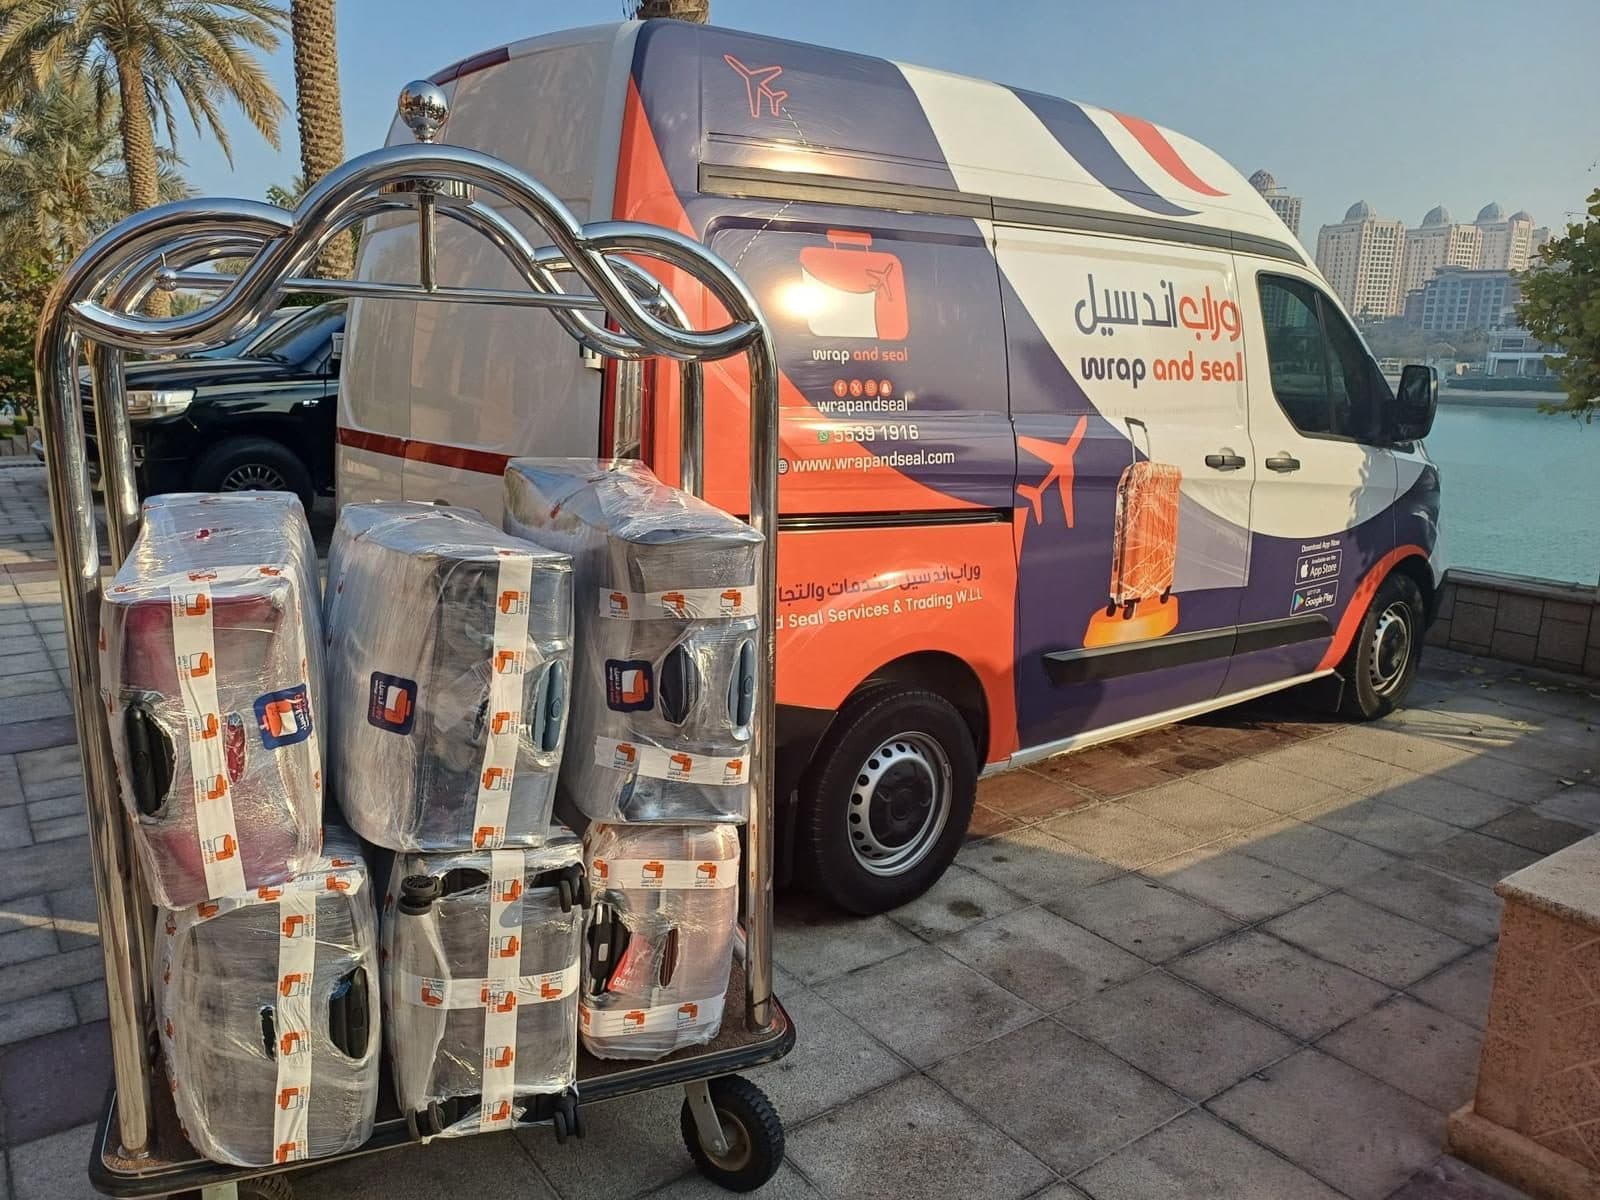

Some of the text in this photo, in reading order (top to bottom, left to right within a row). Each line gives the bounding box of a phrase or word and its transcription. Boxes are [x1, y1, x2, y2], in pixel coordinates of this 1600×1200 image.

[1074, 273, 1242, 342] وراب اندسيل
[812, 347, 908, 364] wrap and seal
[1080, 350, 1244, 389] wrap and seal
[817, 396, 908, 415] wrapandseal
[833, 424, 919, 442] 5539 1916
[792, 450, 955, 473] www.wrapandseal.com
[899, 565, 950, 591] اندسيل
[950, 563, 981, 583] وراب
[1309, 563, 1337, 578] App Store
[1304, 595, 1324, 607] Google
[1324, 592, 1334, 603] Play
[789, 610, 823, 628] Seal
[828, 603, 889, 623] Services
[893, 600, 902, 613] &
[906, 592, 953, 609] Trading
